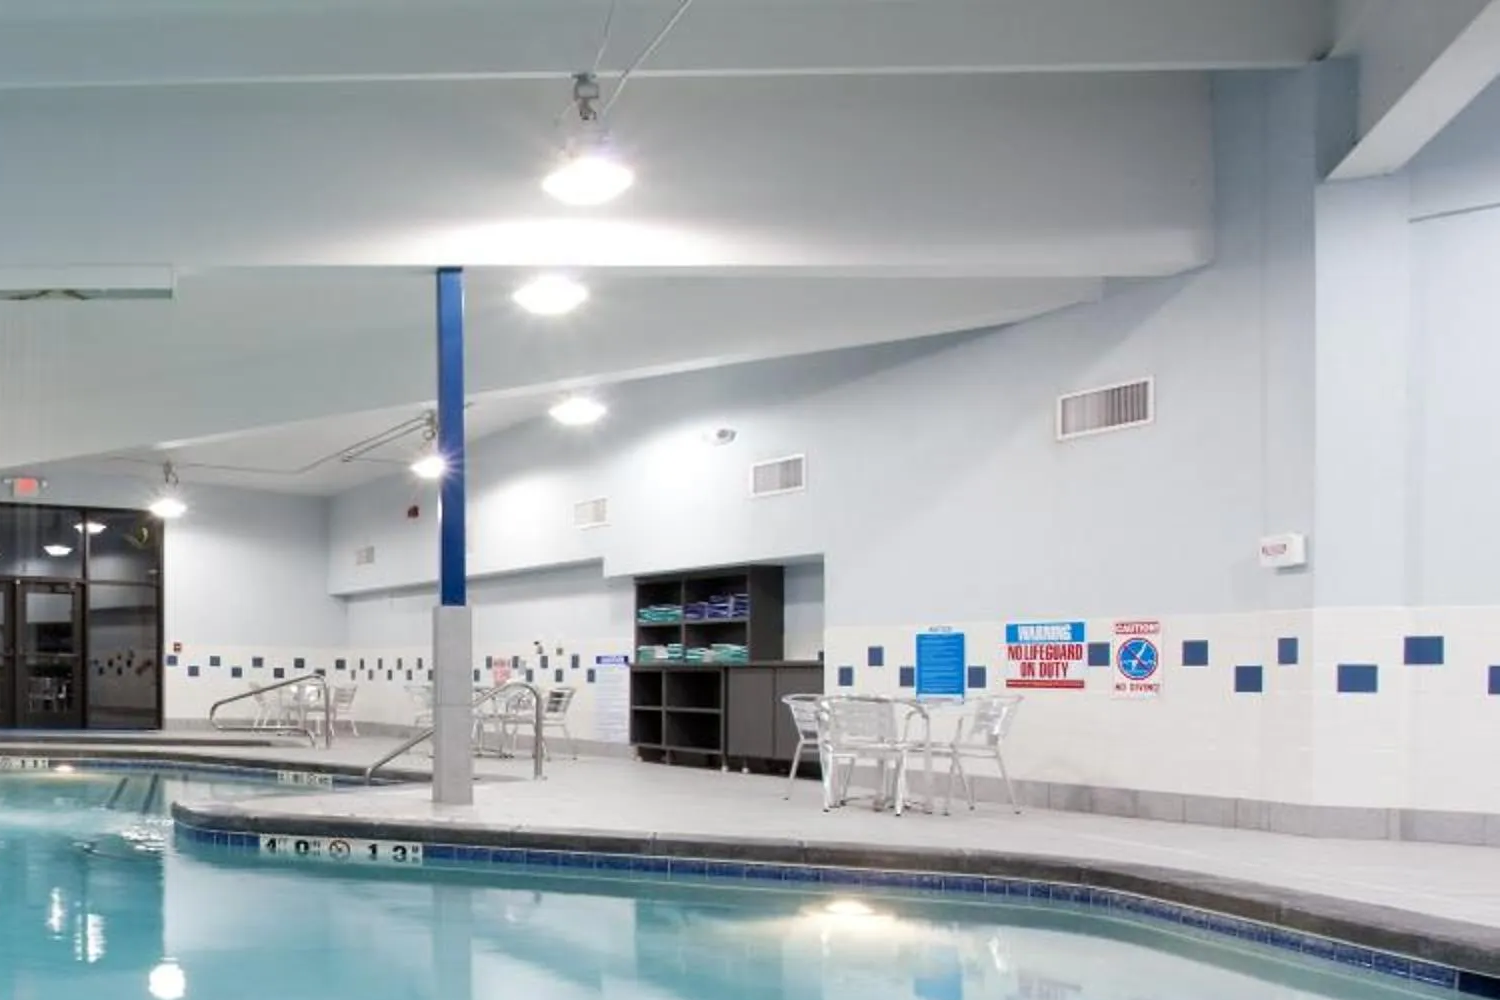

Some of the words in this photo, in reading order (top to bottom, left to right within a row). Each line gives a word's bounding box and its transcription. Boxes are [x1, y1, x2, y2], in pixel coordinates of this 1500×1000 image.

[1017, 624, 1072, 641] WARNING
[1007, 645, 1022, 661] NO
[1024, 643, 1083, 660] LIFEGUARD
[1020, 661, 1035, 678] ON
[1039, 661, 1069, 678] DUTY
